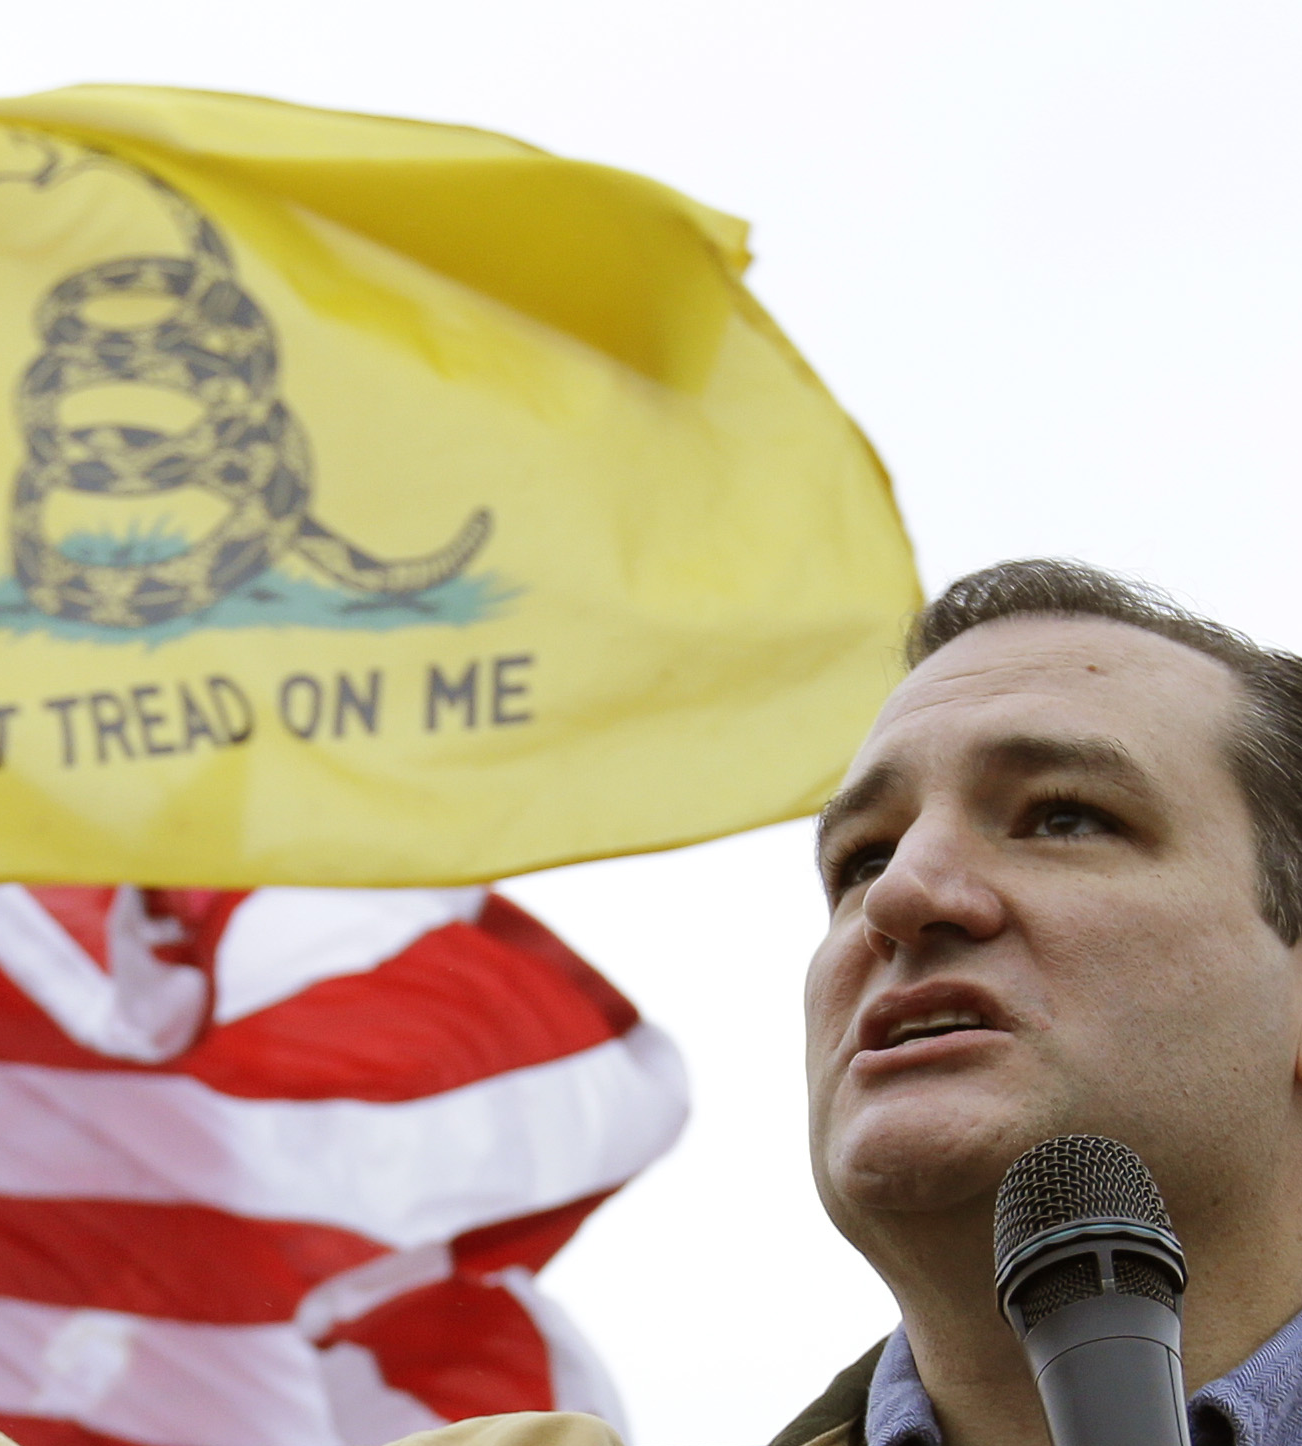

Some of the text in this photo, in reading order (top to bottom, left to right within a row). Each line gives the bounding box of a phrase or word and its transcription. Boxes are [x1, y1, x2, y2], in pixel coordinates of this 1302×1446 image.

[43, 674, 254, 768] TREAD
[278, 669, 382, 741] ON
[425, 654, 536, 735] ME
